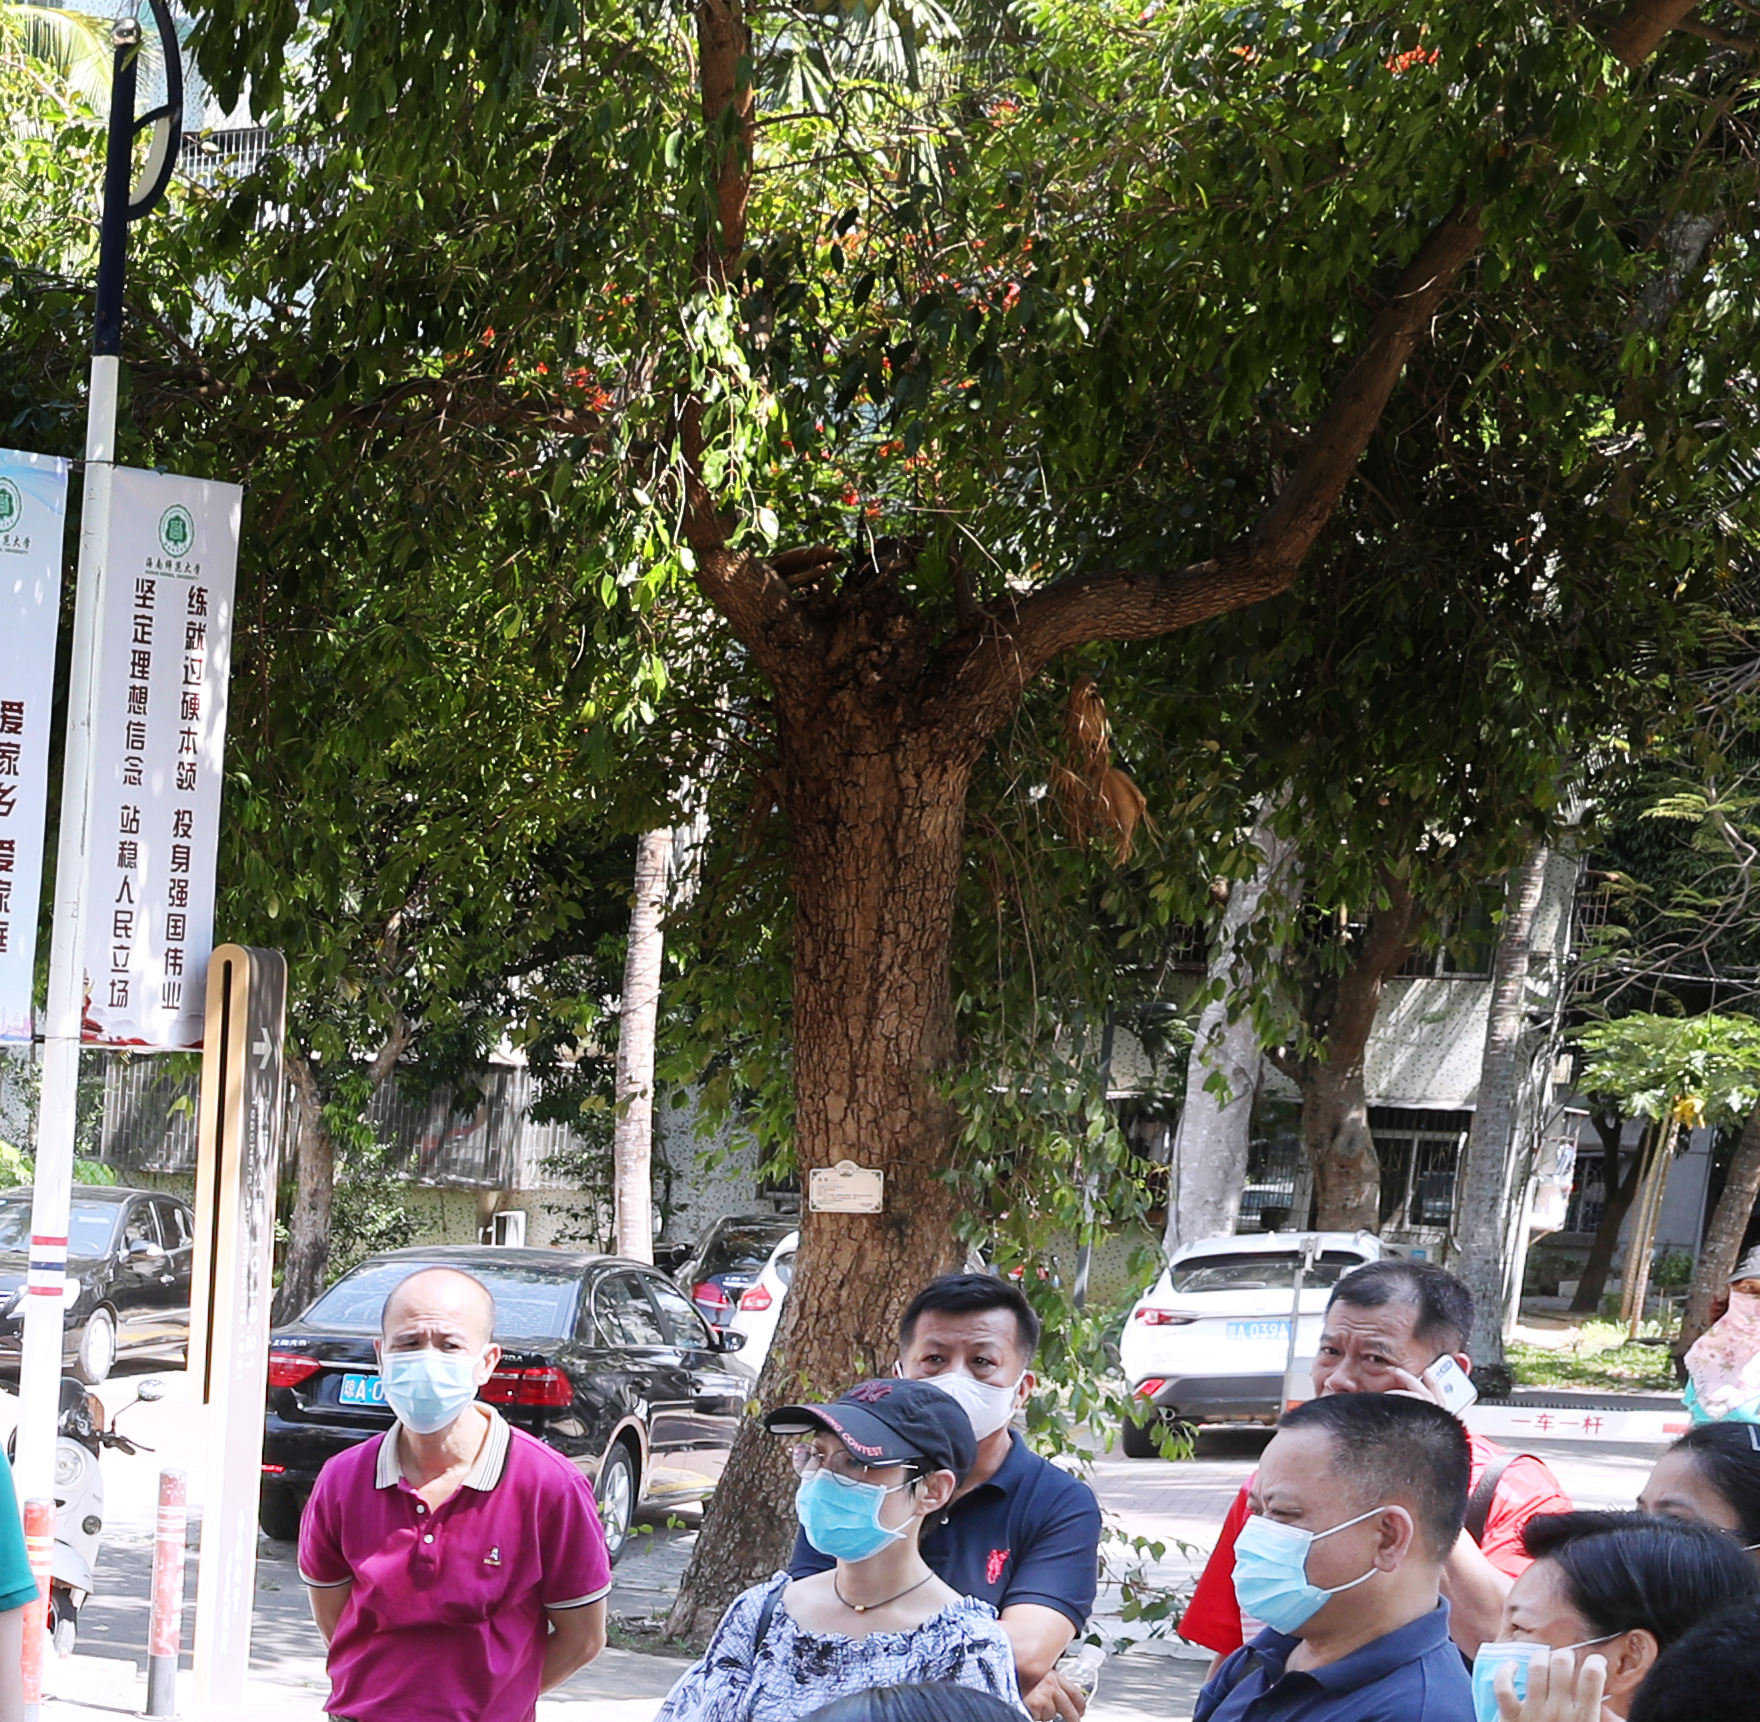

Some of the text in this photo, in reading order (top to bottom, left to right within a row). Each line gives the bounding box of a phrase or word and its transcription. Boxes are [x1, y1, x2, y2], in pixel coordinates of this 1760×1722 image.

[108, 578, 157, 1010] 坚定理想信念 站稳人民立场
[161, 586, 210, 1011] 练就过硬本领 投身强国伟业
[1511, 1413, 1604, 1435] 一车一杆
